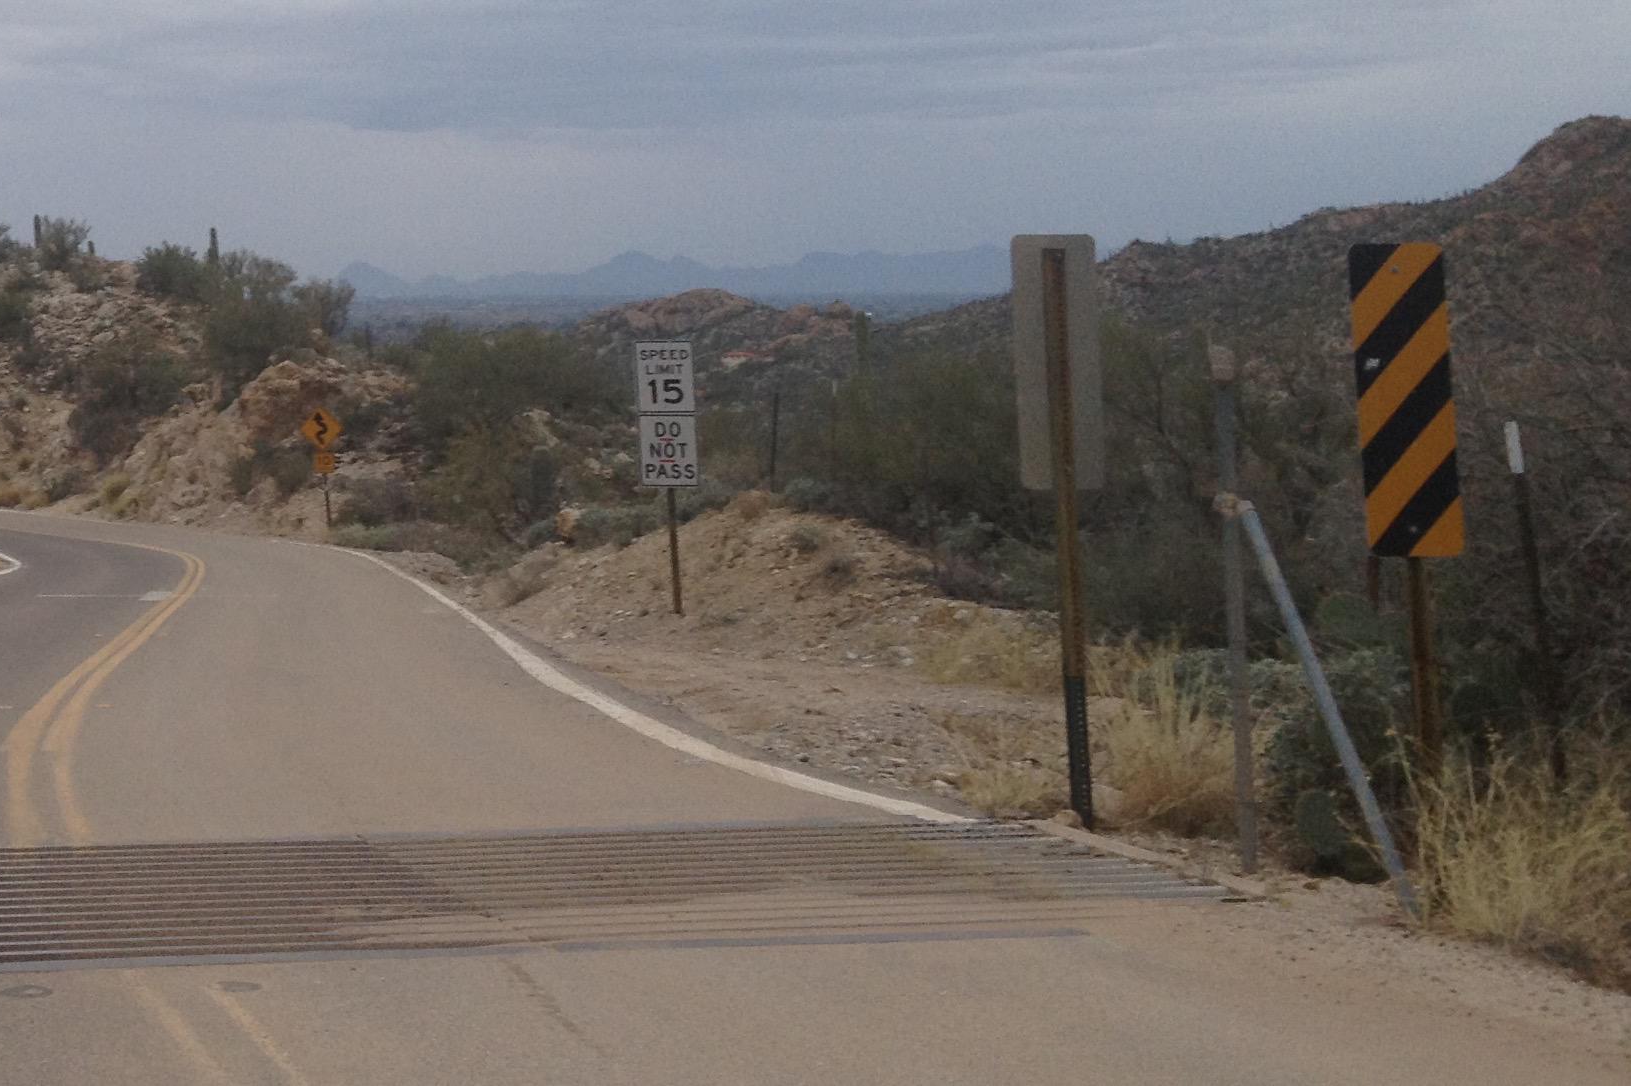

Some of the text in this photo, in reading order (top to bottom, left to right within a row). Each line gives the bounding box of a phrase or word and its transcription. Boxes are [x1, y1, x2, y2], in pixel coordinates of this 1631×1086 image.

[640, 349, 689, 361] SPEED
[646, 363, 684, 375] LIMIT
[648, 379, 684, 405] 15
[655, 421, 681, 437] DO
[650, 443, 687, 458] NOT
[645, 464, 695, 479] PASS
